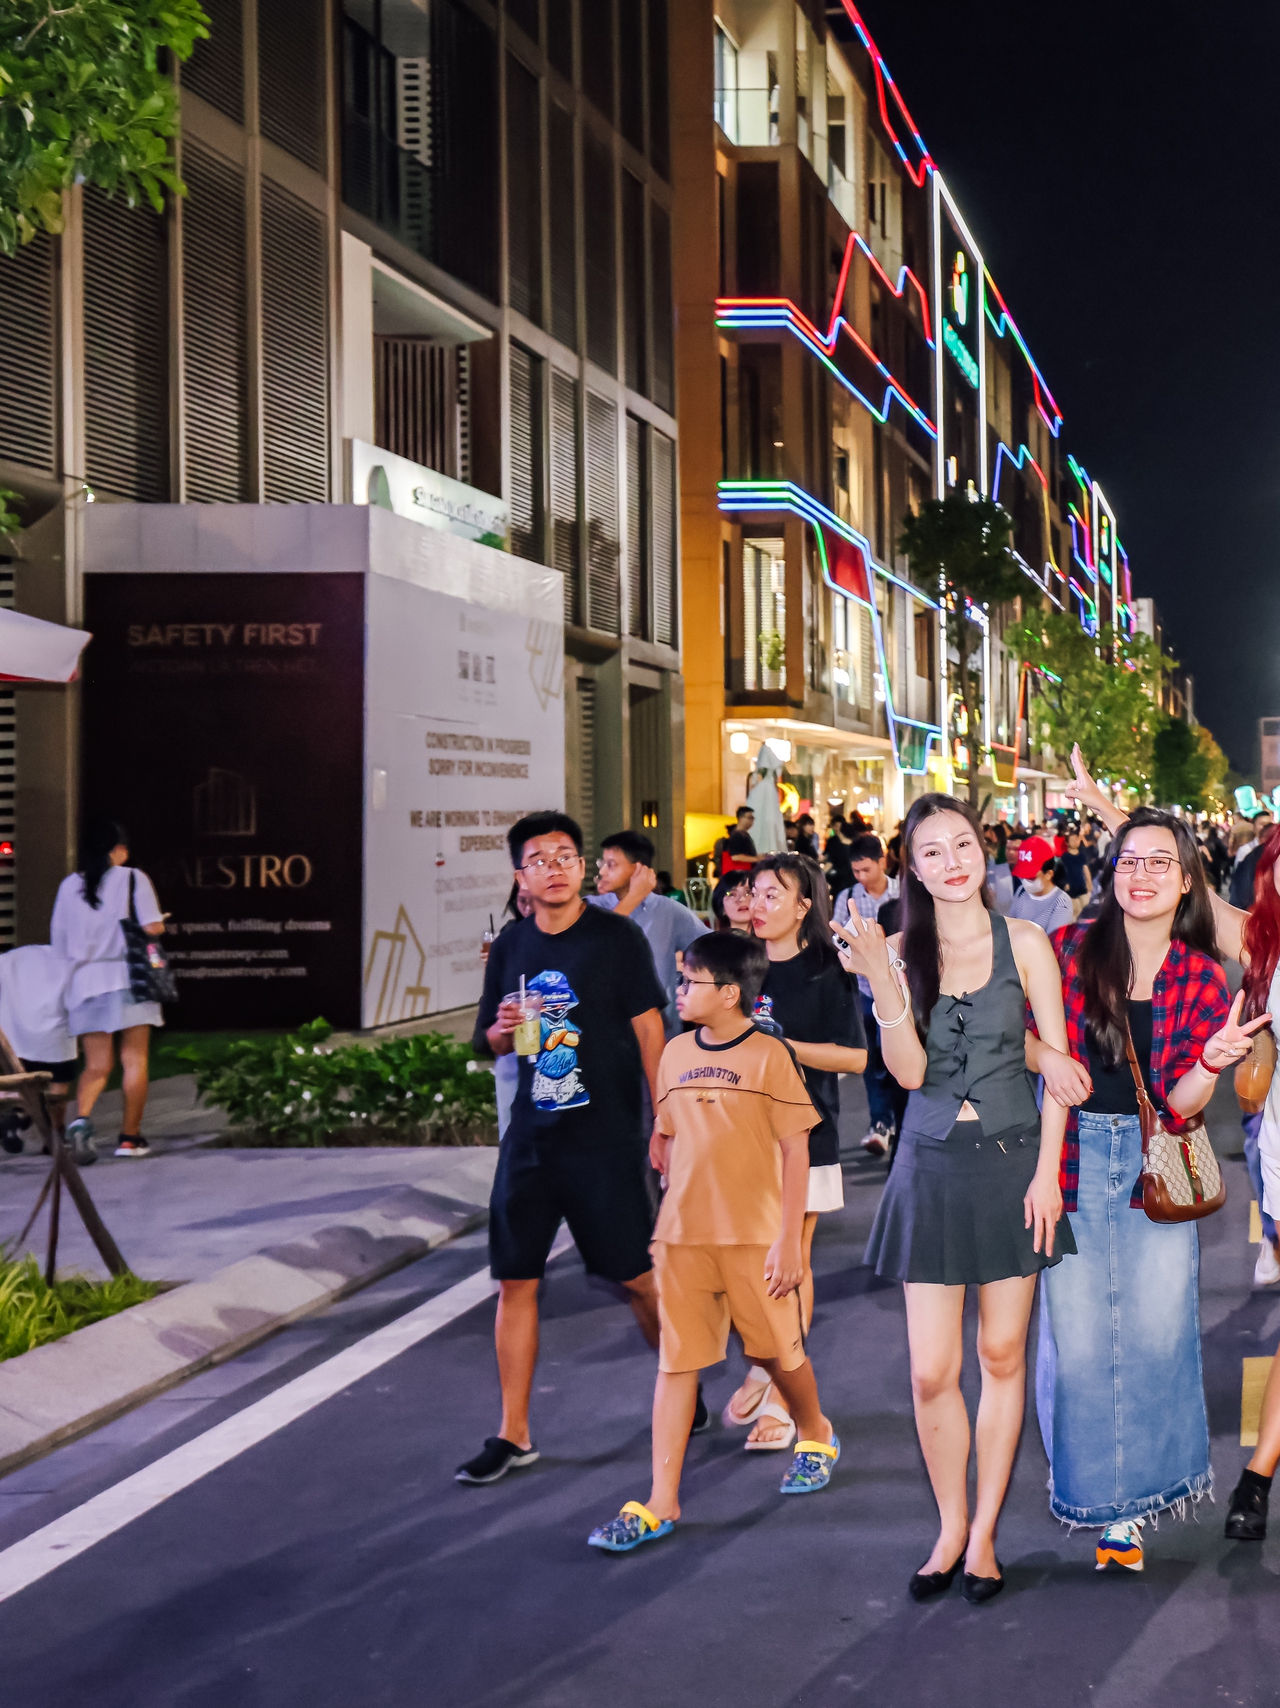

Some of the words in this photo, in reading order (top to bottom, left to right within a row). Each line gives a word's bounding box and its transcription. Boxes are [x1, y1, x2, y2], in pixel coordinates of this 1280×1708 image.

[128, 623, 235, 646] SAFETY
[243, 622, 322, 646] FIRST
[426, 731, 484, 751] CONSTRUCTION
[429, 758, 455, 775] SORRY
[458, 760, 472, 776] FOR
[410, 810, 423, 828] WE
[425, 810, 442, 828] ARE
[444, 810, 480, 827] WORKING
[679, 1066, 741, 1085] WASHINGTON
